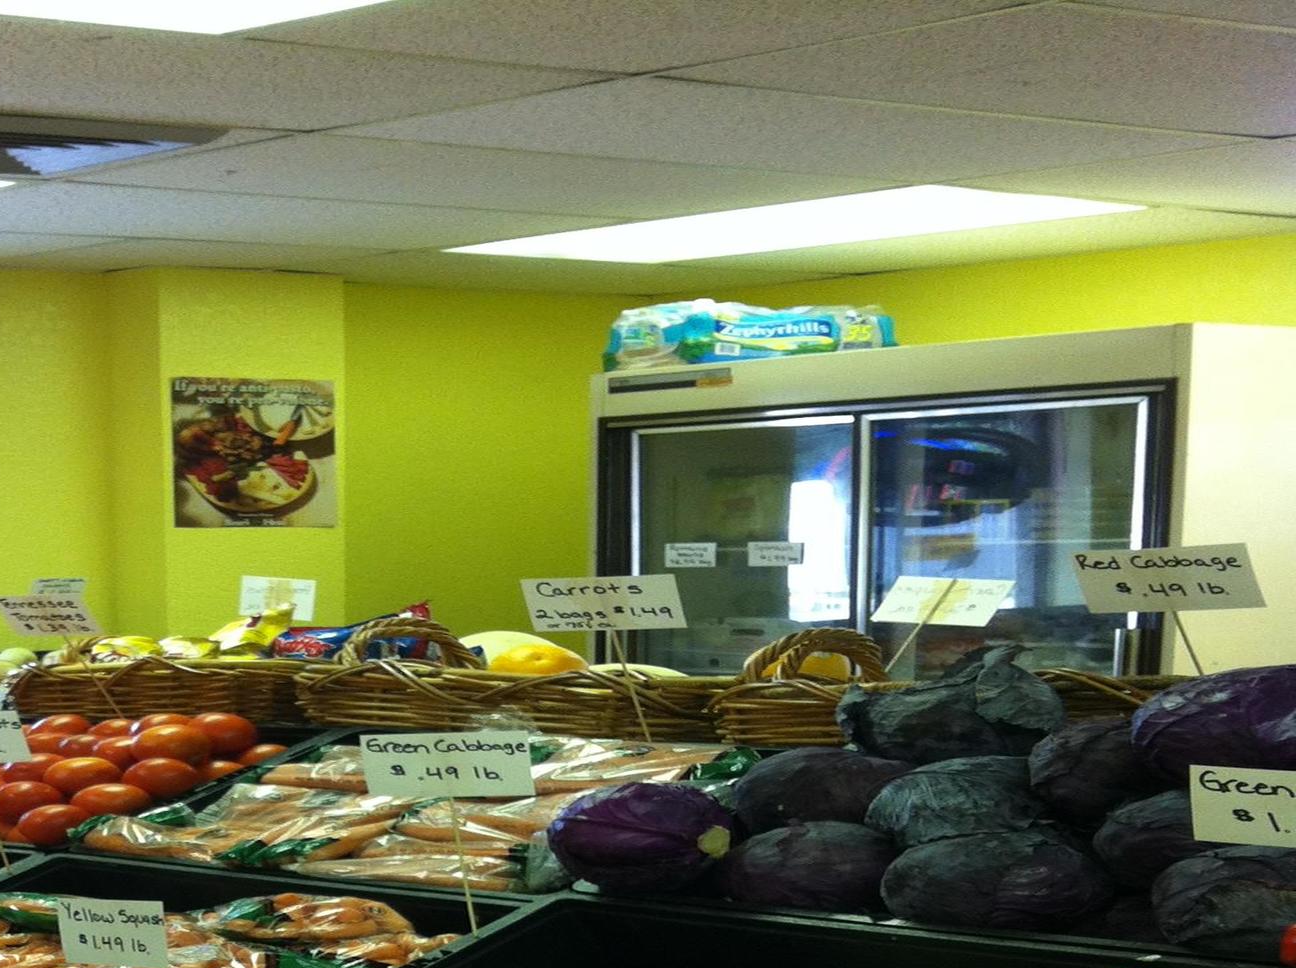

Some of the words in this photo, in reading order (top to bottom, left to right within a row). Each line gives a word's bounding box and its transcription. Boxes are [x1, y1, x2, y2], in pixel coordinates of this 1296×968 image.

[718, 321, 831, 340] Zephyrhills
[1075, 554, 1121, 571] Red
[1130, 555, 1243, 572] Cabbage
[535, 581, 644, 598] Carrots
[1197, 582, 1231, 597] lb.
[535, 609, 554, 620] 2
[555, 609, 607, 621] bags
[365, 738, 431, 755] Green
[433, 739, 528, 756] Cabbage
[473, 766, 504, 782] lb.
[1198, 769, 1296, 799] Green
[61, 901, 115, 924] Yellow
[117, 909, 165, 929] Squash
[131, 937, 151, 956] lb.
